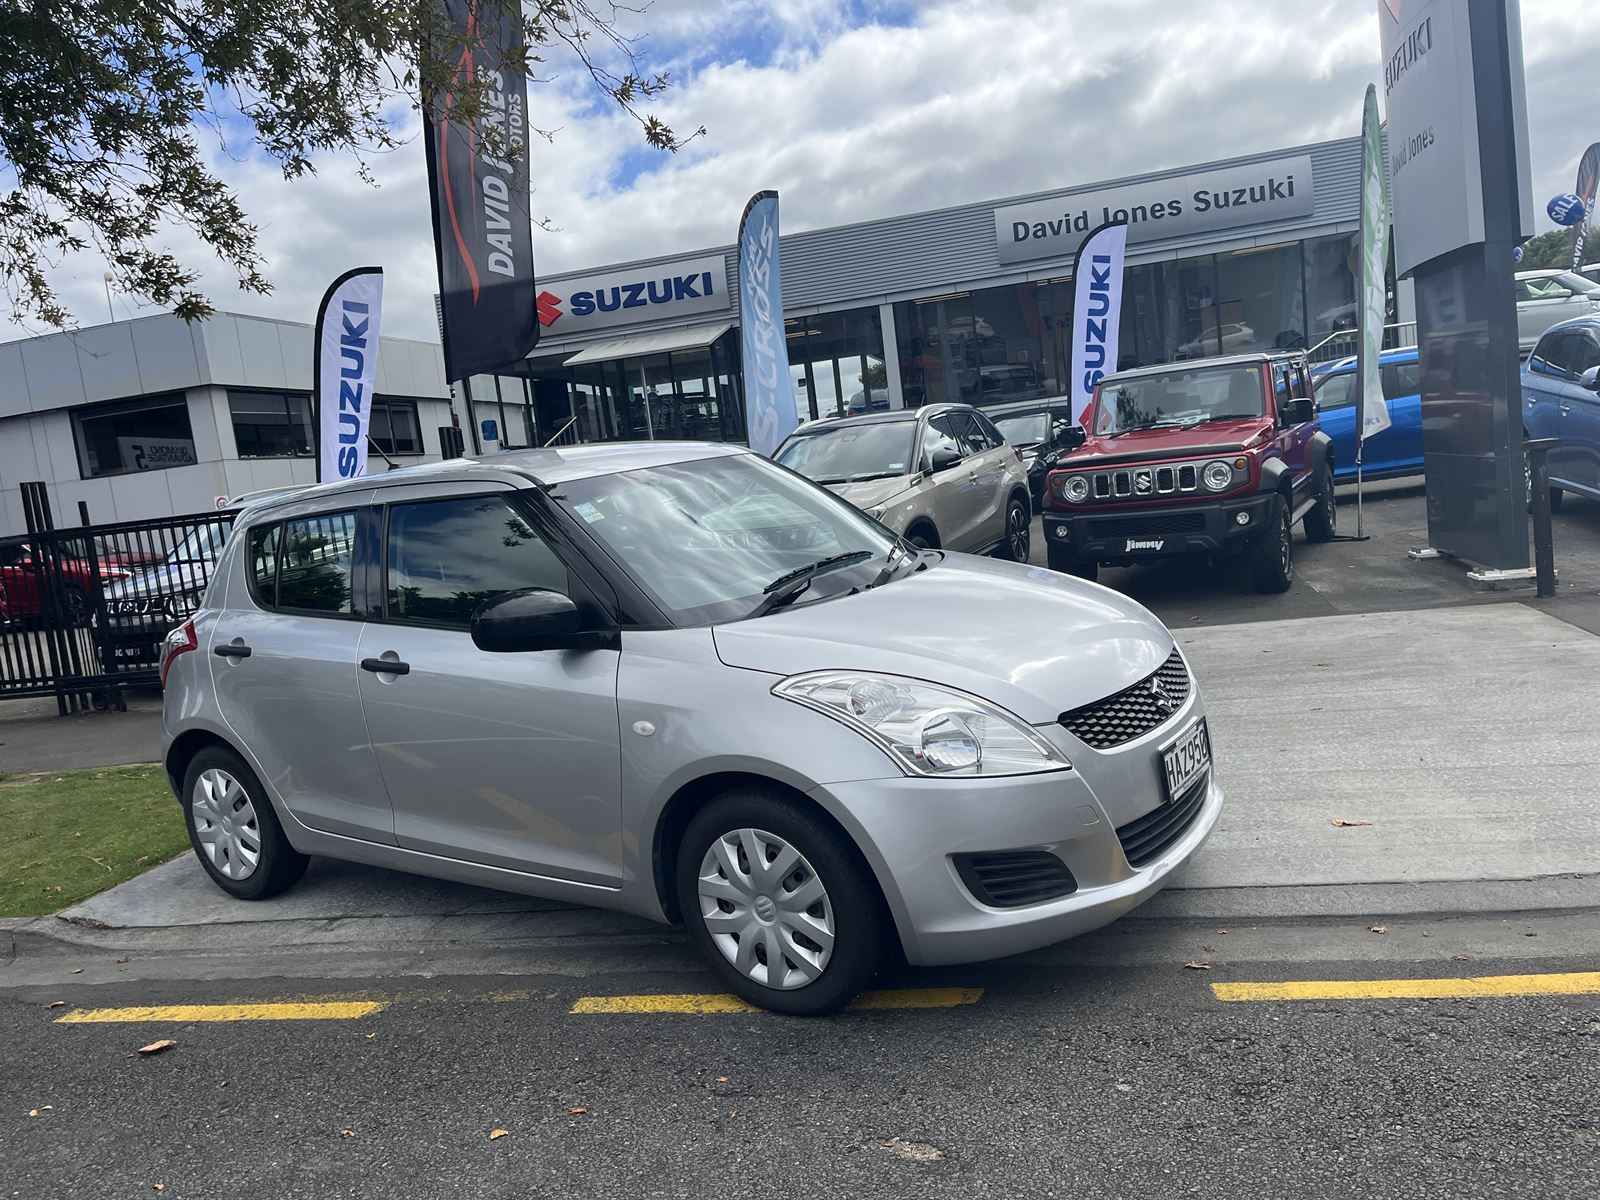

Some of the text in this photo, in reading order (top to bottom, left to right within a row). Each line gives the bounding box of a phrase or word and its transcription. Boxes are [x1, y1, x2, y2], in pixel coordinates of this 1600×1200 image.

[1408, 125, 1435, 161] Jones
[482, 174, 514, 278] DAVID
[1012, 175, 1294, 243] David Jones Suzuki
[1551, 192, 1579, 221] SALE
[569, 271, 714, 316] SUZUKI
[1083, 255, 1111, 395] SUZUKI
[337, 299, 369, 478] SUZUKI
[1165, 728, 1208, 792] HAZ950
